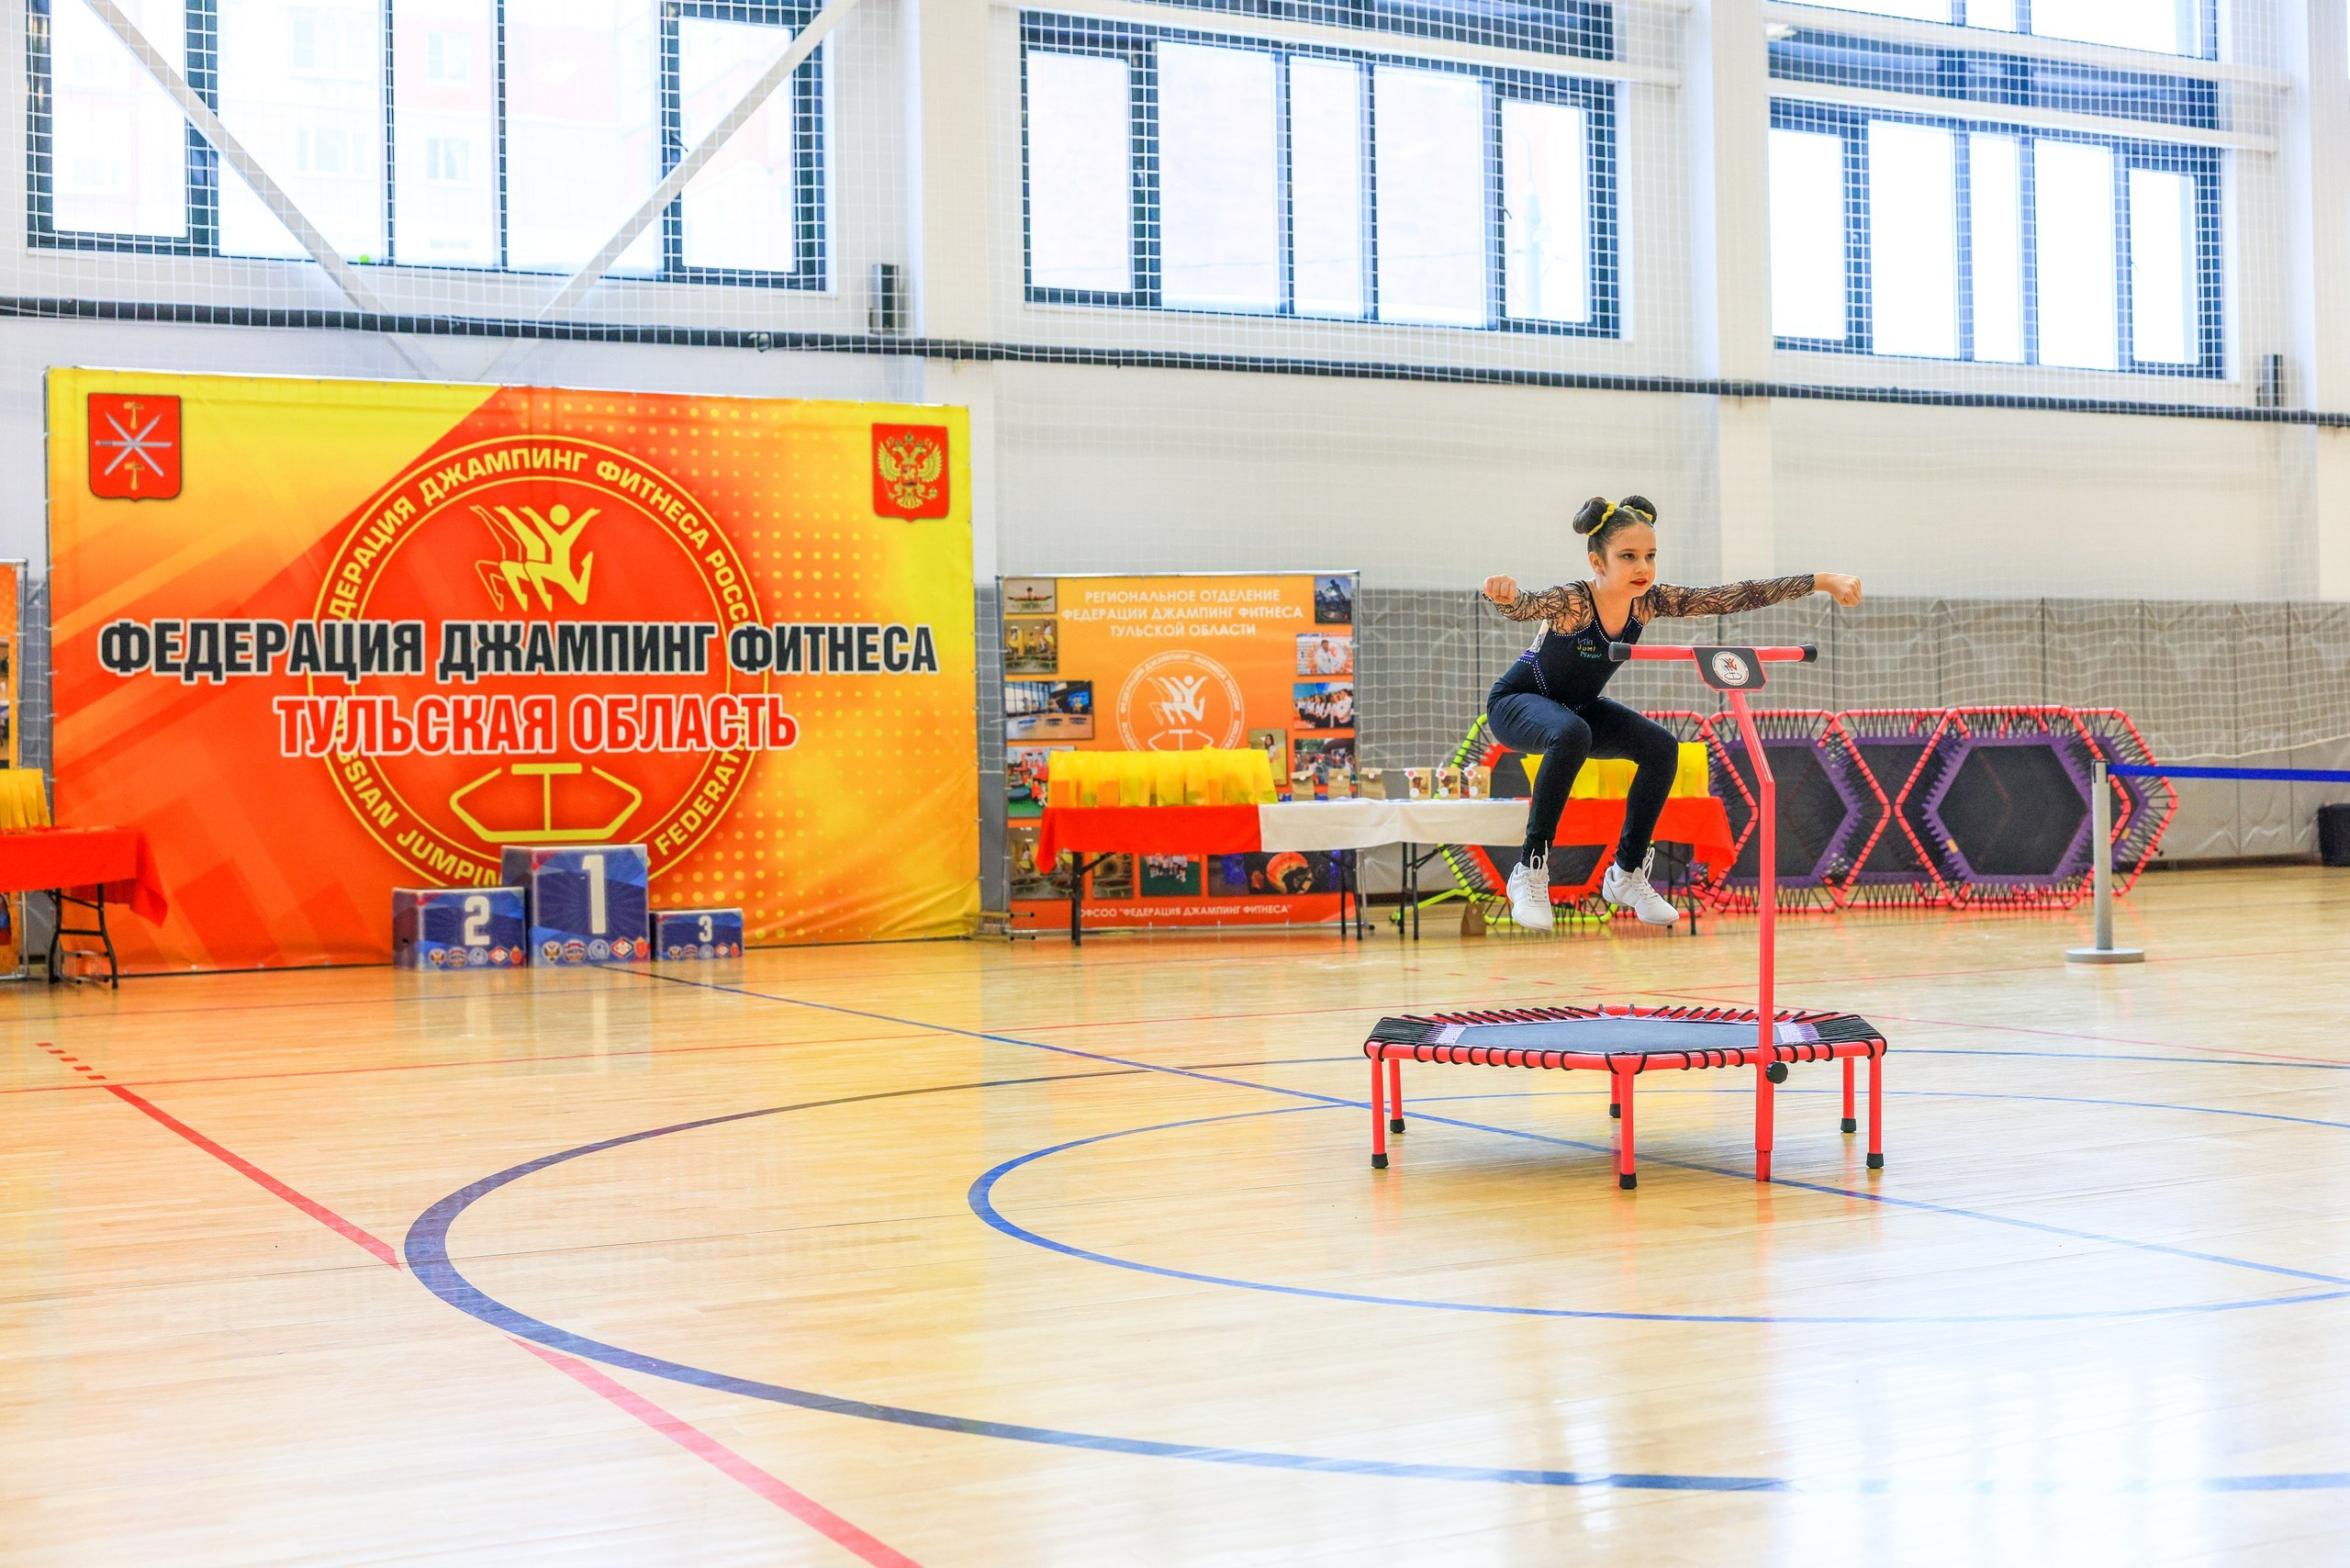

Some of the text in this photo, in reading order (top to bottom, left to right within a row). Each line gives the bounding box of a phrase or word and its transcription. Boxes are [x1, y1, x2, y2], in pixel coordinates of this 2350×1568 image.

[329, 447, 751, 627] ДЕРАЦИЯ ДЖАМПИНГ ФИТНЕСА РОСС
[1061, 605, 1304, 622] ФЕДЕРАЦИИ ДЖАМПИНГ ФИТНЕСА
[1084, 588, 1281, 603] РЕГИОНАЛЬНОЕ ОТДЕЛЕНИЕ
[98, 619, 941, 684] ФЕДЕРАЦИЯ ДЖАМПИНГ ФИТНЕСА
[1109, 622, 1257, 638] ТУЛЬСКОЙ ОБЛАСТИ
[274, 693, 800, 755] ТУЛЬСКАЯ ОБЛАСТЬ
[397, 829, 502, 887] JUMPIN
[581, 854, 608, 935] 1
[1183, 905, 1241, 916] ДЖАМПИНГ
[464, 895, 491, 946] 2
[699, 914, 713, 943] 3
